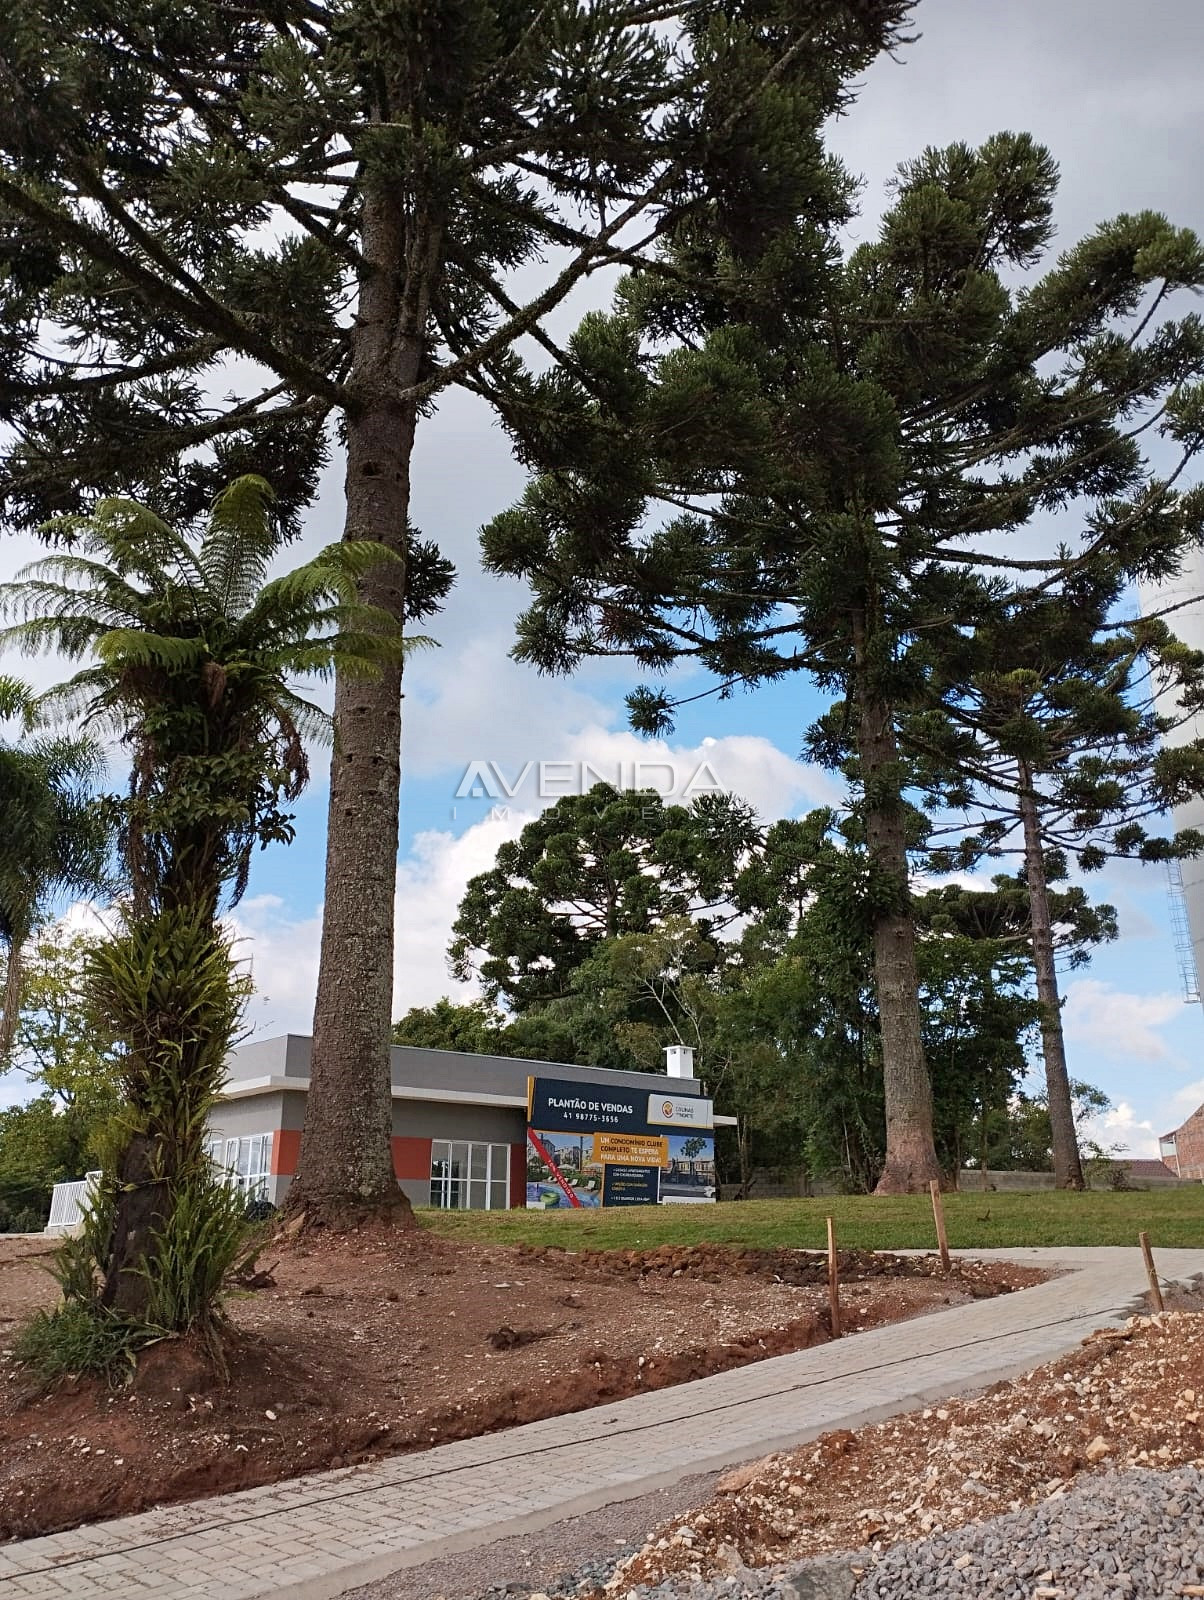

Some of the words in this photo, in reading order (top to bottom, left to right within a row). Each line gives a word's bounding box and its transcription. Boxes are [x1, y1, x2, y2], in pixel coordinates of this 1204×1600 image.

[548, 1097, 587, 1110] PLANTÃO
[588, 1101, 600, 1111] DE
[601, 1102, 633, 1114] VENDAS
[563, 1111, 572, 1119] 41
[600, 1136, 610, 1144] UM
[610, 1137, 646, 1147] CONDOMÍNIO
[600, 1145, 630, 1153] COMPLETO
[600, 1153, 616, 1161] PARA
[617, 1154, 630, 1162] UMA
